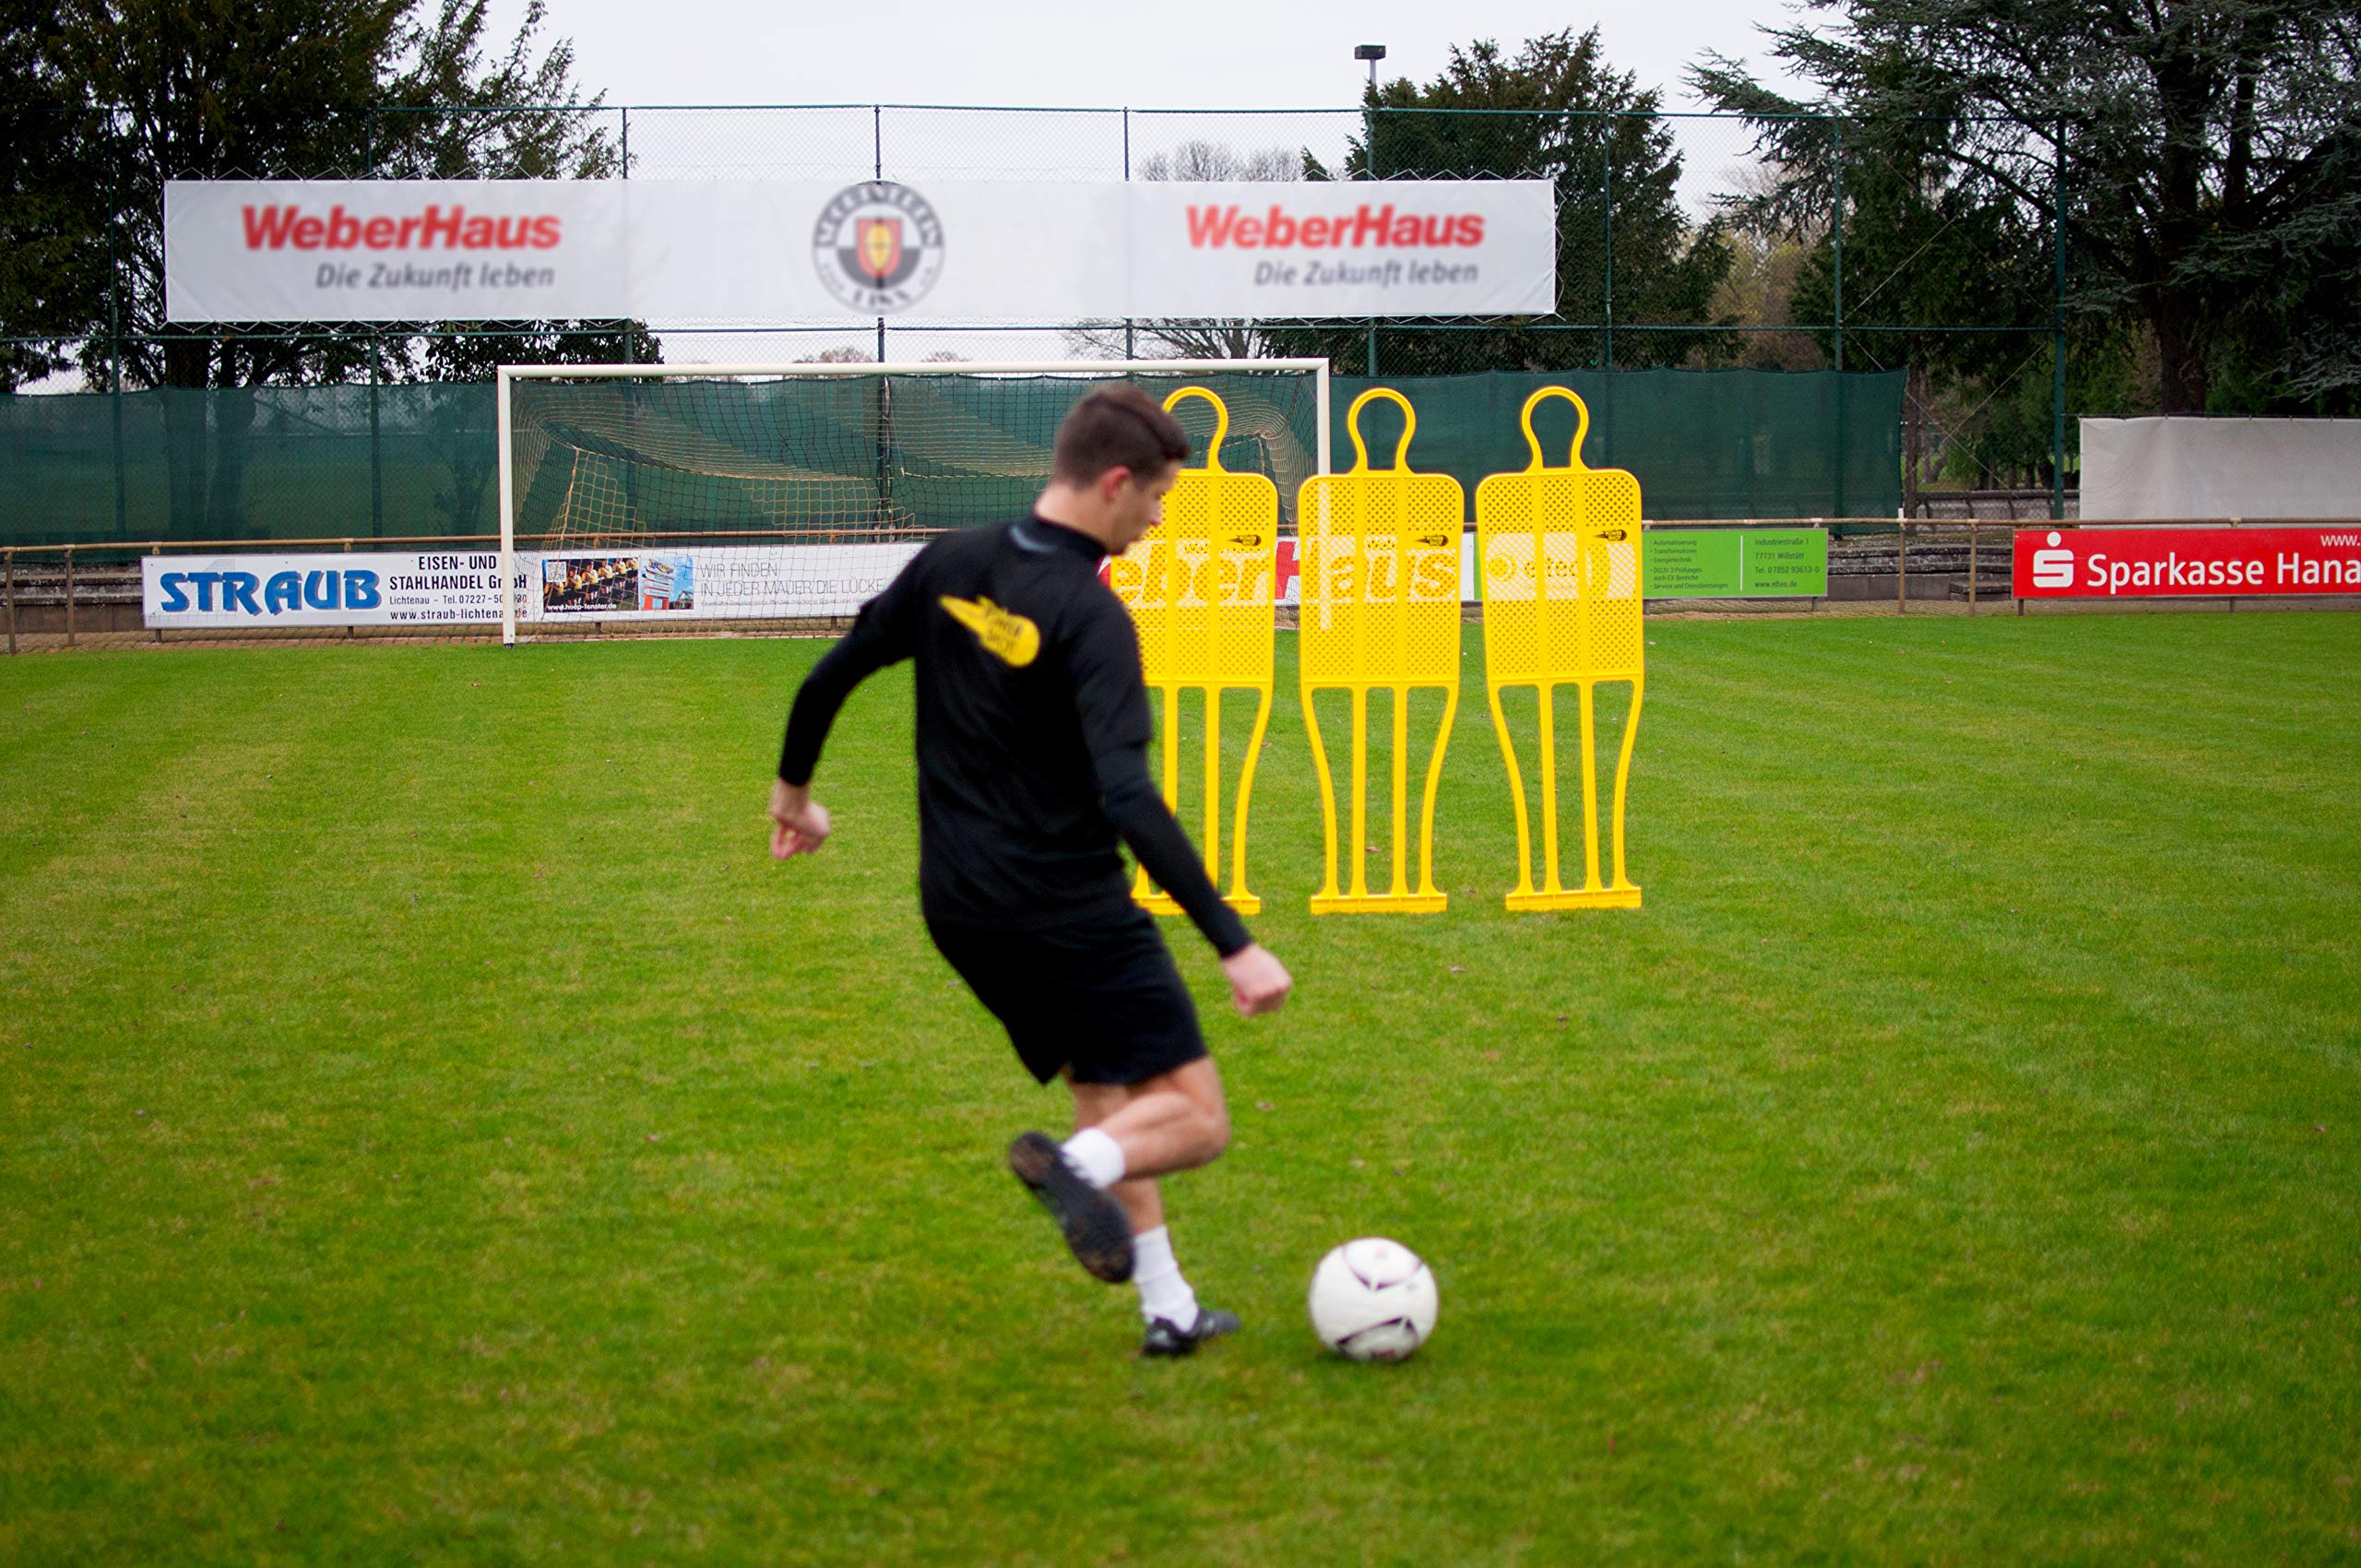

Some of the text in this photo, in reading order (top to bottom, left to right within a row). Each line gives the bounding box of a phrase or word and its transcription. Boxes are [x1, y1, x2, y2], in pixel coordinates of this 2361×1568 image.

[241, 204, 562, 251] WeberHaus
[1186, 204, 1486, 248] WeberHaus
[315, 262, 555, 293] Die Zukunft leben
[1254, 259, 1479, 290] Die Zukunft leben
[1755, 538, 1803, 546] Industriestraße
[419, 555, 497, 570] EISEN- UND
[700, 563, 777, 578] WIR FINDEN
[1097, 541, 1455, 604] eberHaus
[2086, 552, 2361, 595] Sparkasse Hana
[160, 570, 381, 615] STRAUB
[389, 575, 527, 590] STAHLHANDEL GH
[701, 577, 884, 597] IN JEDER MAUER DIE LÜCKE
[389, 595, 430, 605] Lichtenau
[443, 595, 457, 604] Tel.
[459, 594, 528, 604] 07227-5030
[390, 608, 528, 620] www.straub-lichtenade
